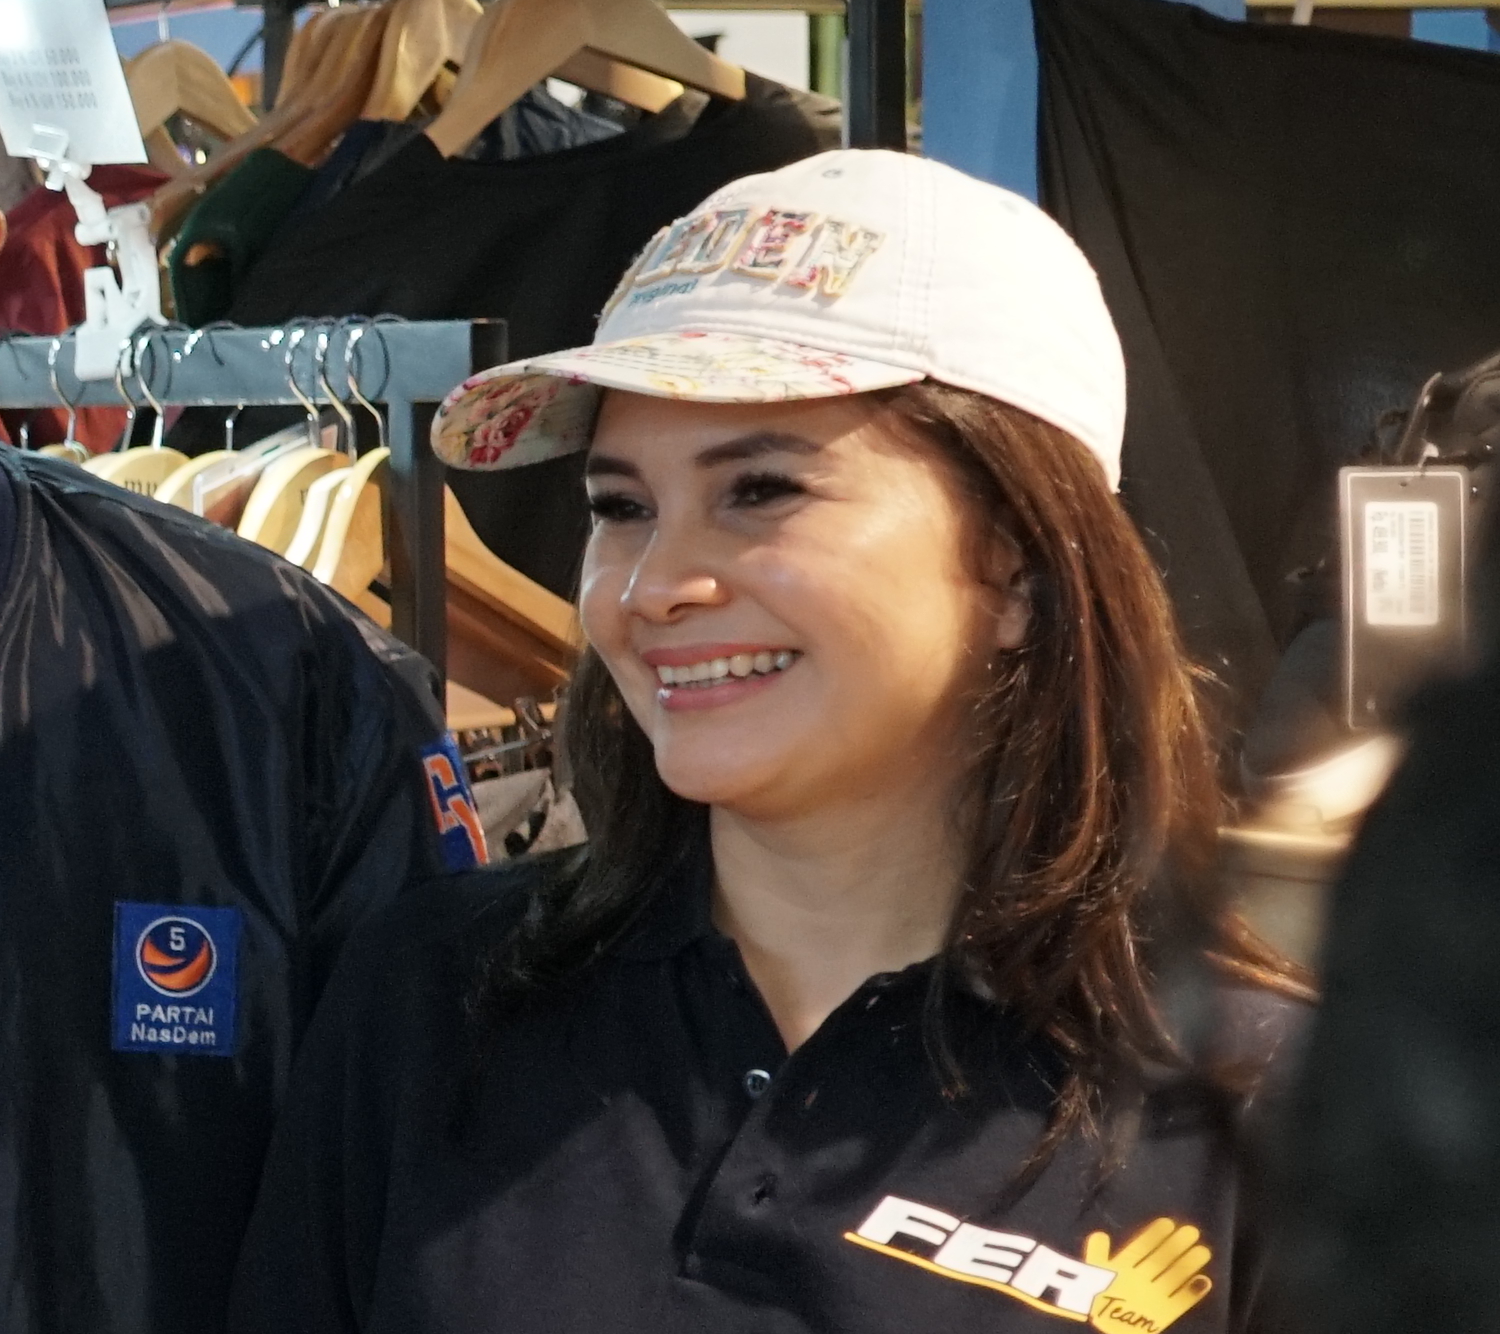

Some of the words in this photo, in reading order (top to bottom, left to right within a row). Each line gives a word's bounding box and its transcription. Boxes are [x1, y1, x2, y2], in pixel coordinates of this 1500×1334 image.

[169, 927, 186, 951] 5
[136, 1003, 214, 1026] PARTAI
[131, 1022, 217, 1046] NasDem
[856, 1194, 1118, 1316] FER
[1098, 1295, 1160, 1334] Team
